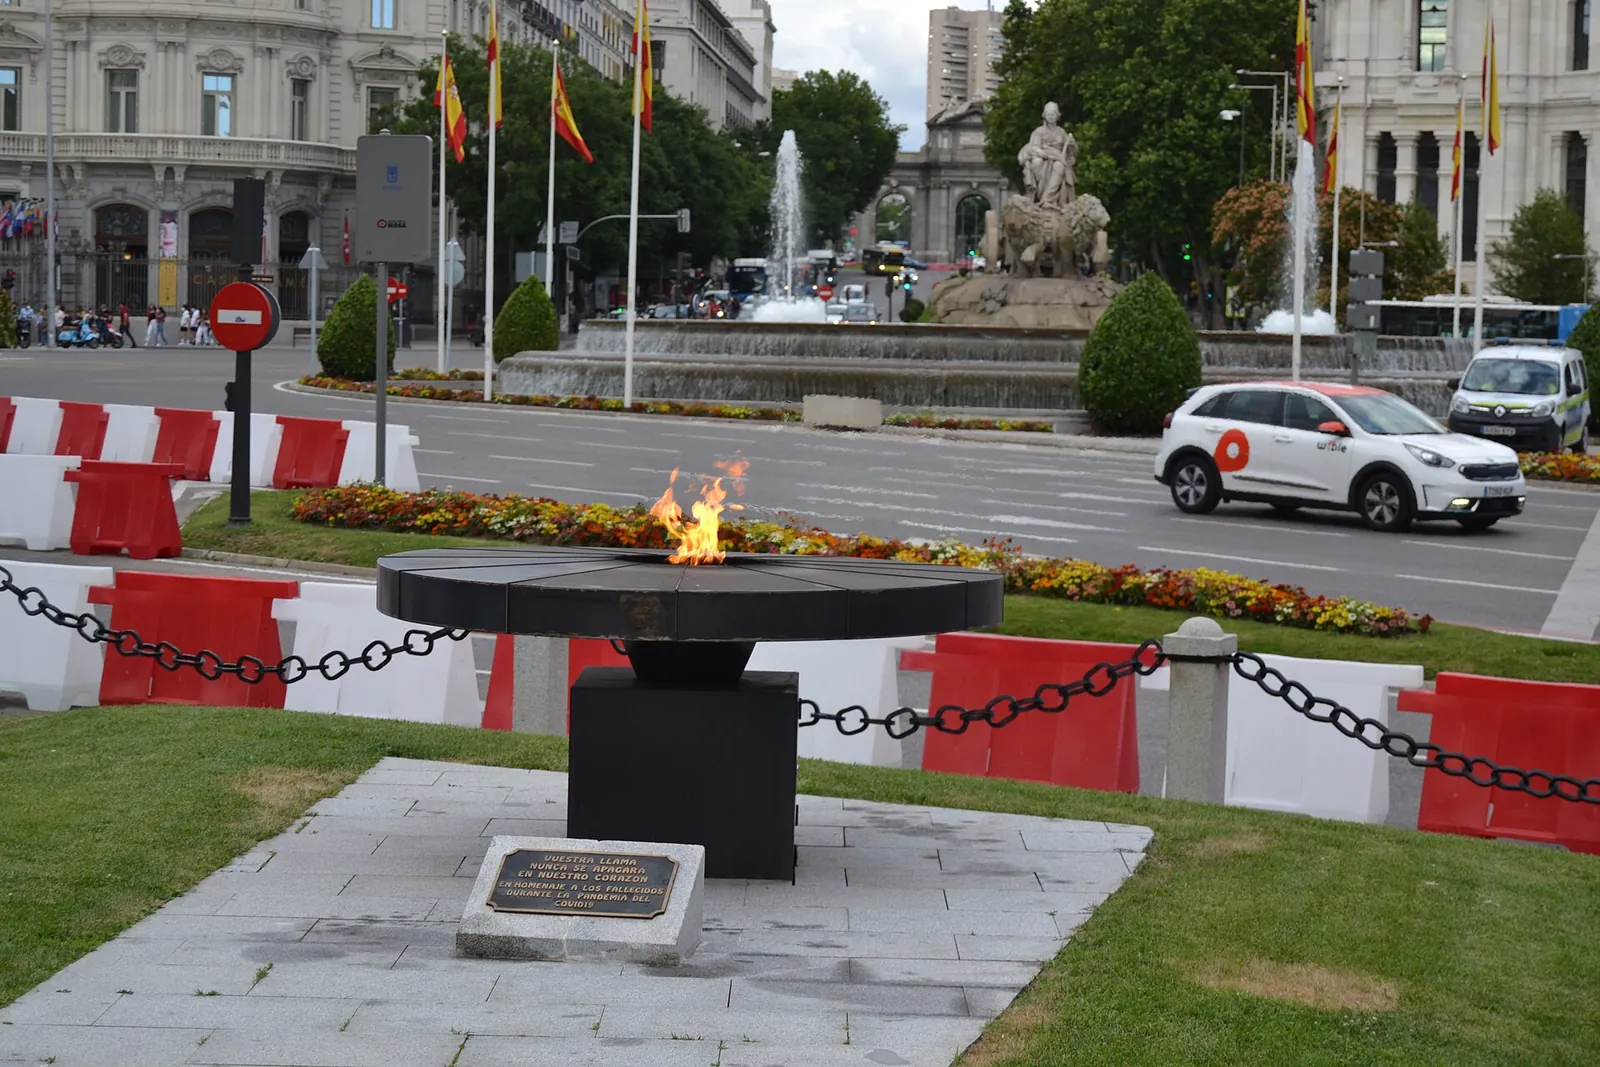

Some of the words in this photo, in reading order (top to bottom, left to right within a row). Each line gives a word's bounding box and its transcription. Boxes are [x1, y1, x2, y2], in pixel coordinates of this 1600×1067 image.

[1316, 440, 1347, 454] wible
[544, 855, 594, 863] VUESTRA
[600, 857, 637, 866] LLAMA
[530, 863, 567, 871] NUNCA
[518, 870, 533, 878] EN
[538, 872, 589, 881] NUESTRO
[514, 881, 566, 890] HOMENAJE
[606, 886, 664, 895] FALLECIDOS
[507, 890, 552, 898] DURANTE
[577, 893, 628, 901] PANDEMIA
[554, 900, 594, 909] COVID19
